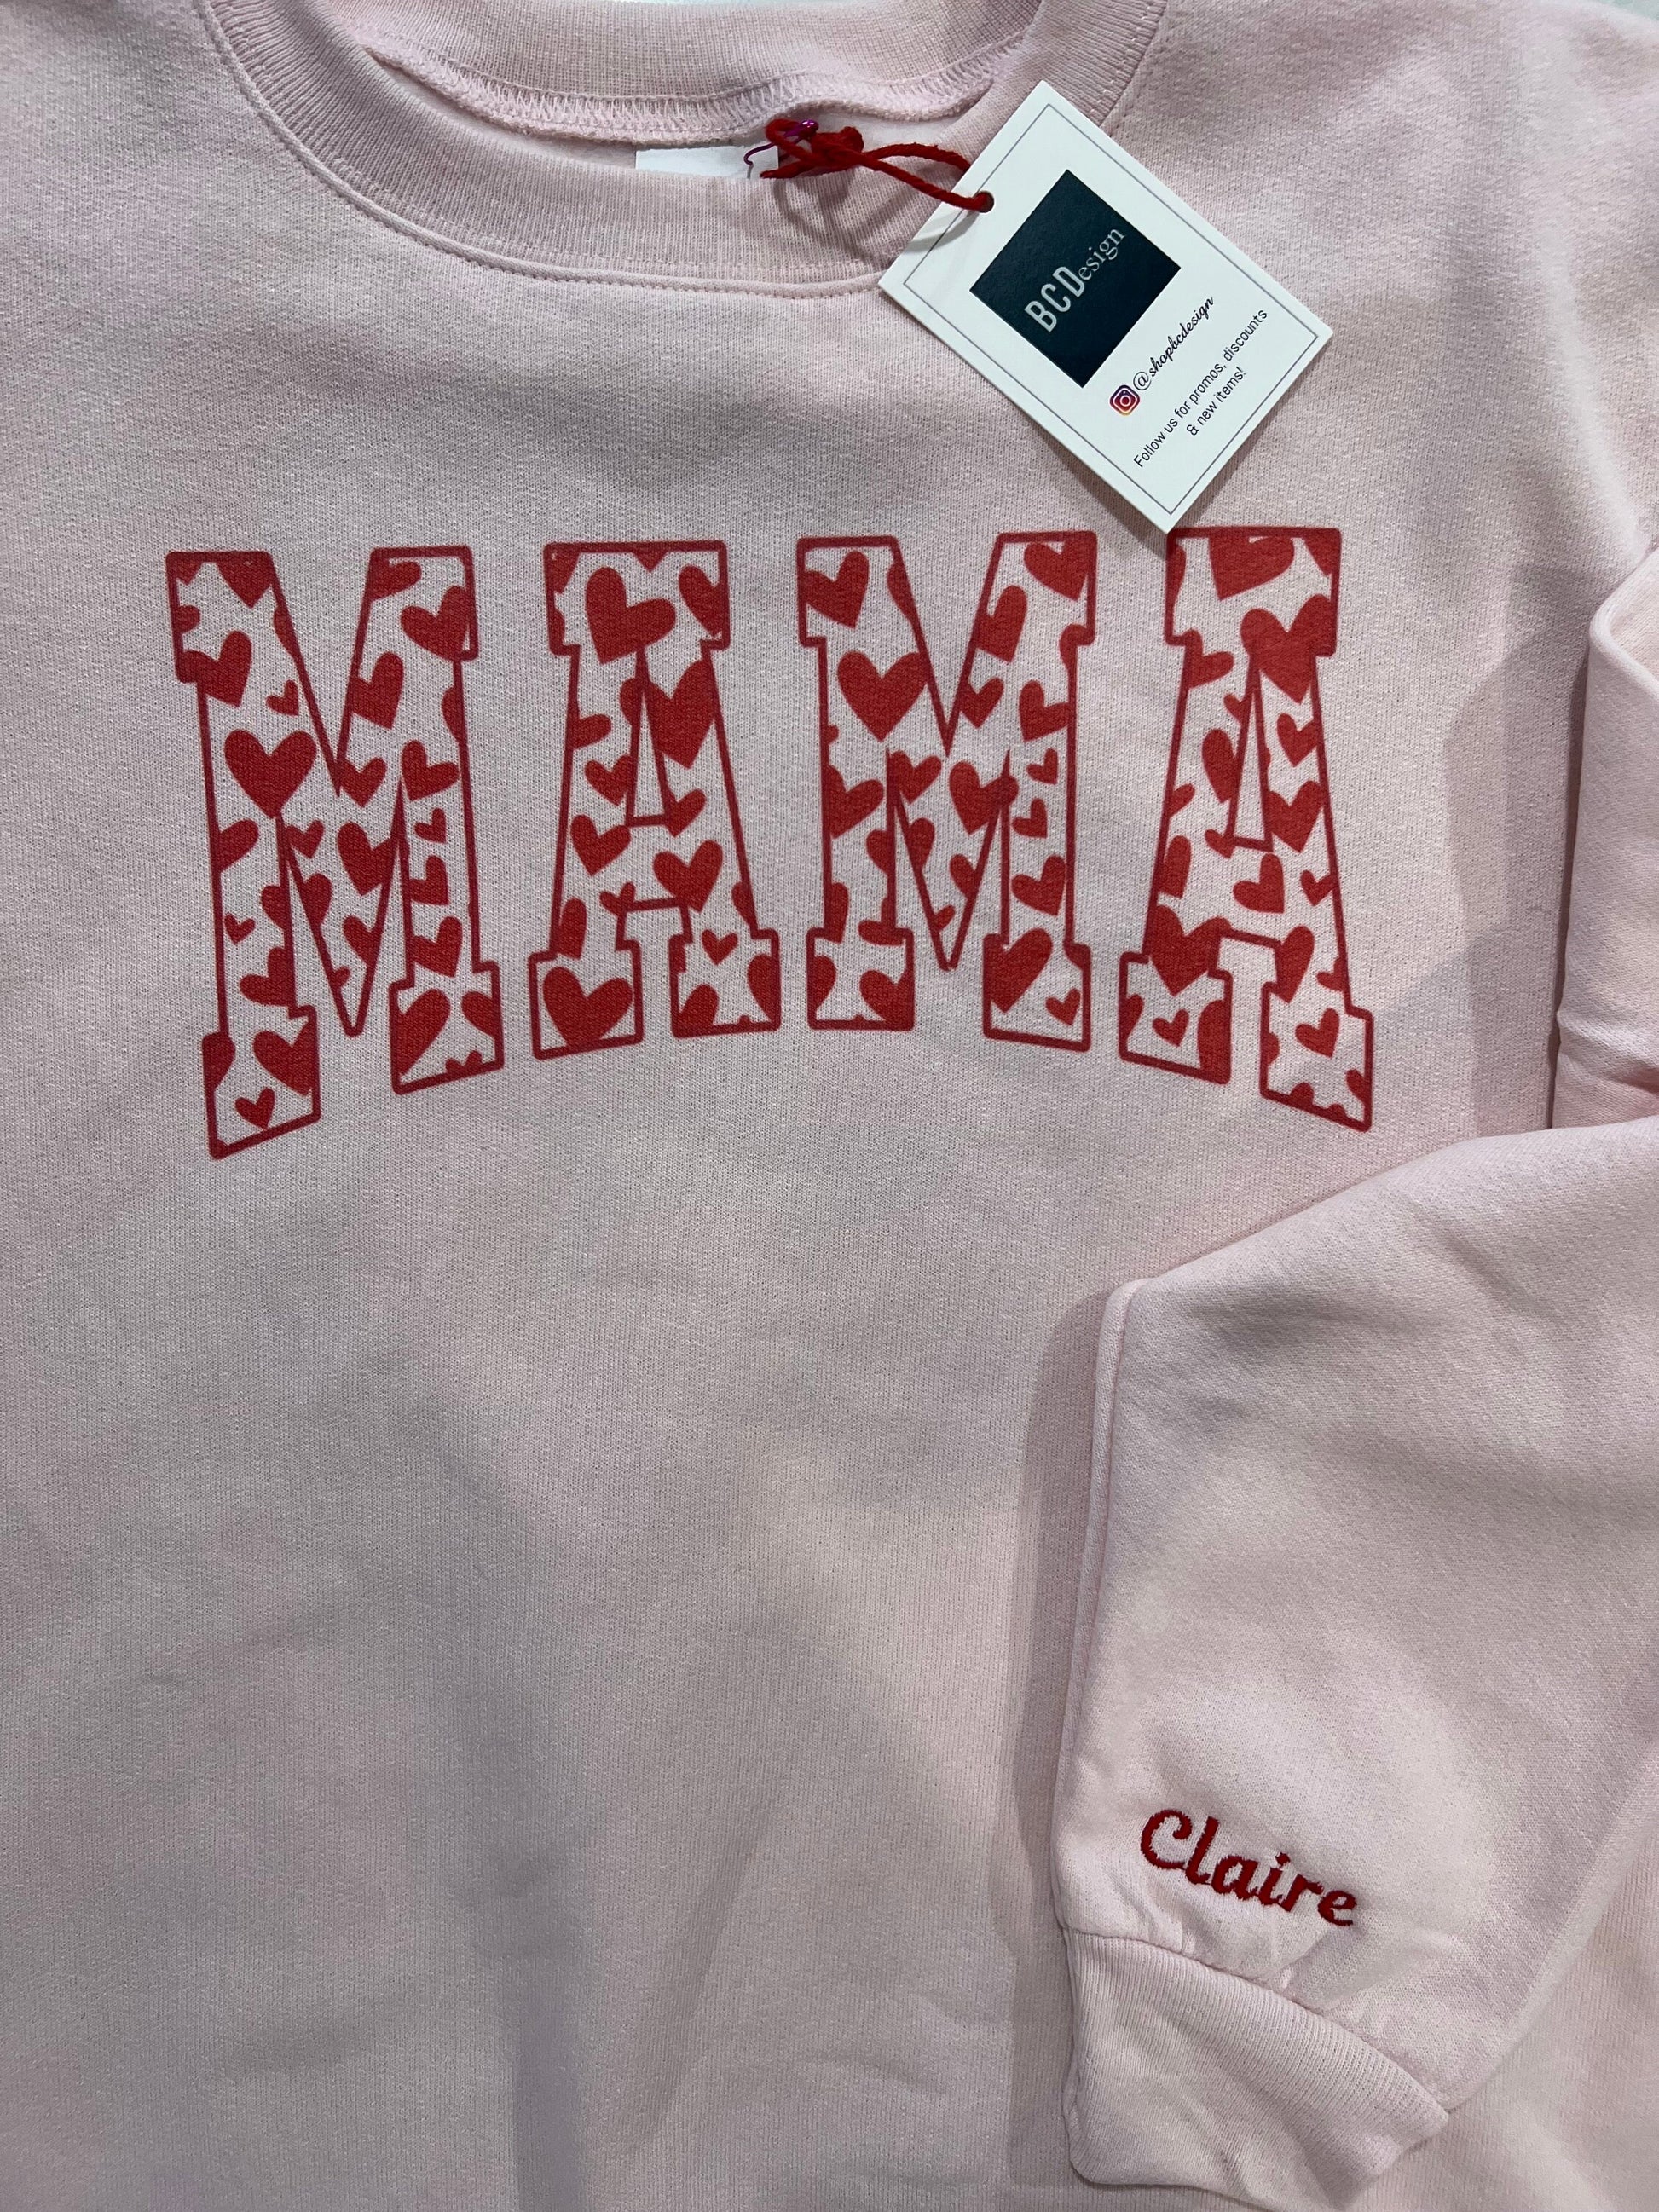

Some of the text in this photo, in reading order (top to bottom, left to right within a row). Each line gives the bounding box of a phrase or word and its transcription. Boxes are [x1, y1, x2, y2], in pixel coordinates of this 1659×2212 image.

[1024, 228, 1126, 333] BCDesign
[1133, 297, 1214, 391] @shopbcdesign
[1133, 309, 1269, 468] Follow us for promos, discounts
[1186, 366, 1246, 436] & new items!
[166, 526, 1374, 1159] MAMA
[1140, 1809, 1358, 1926] Claire
